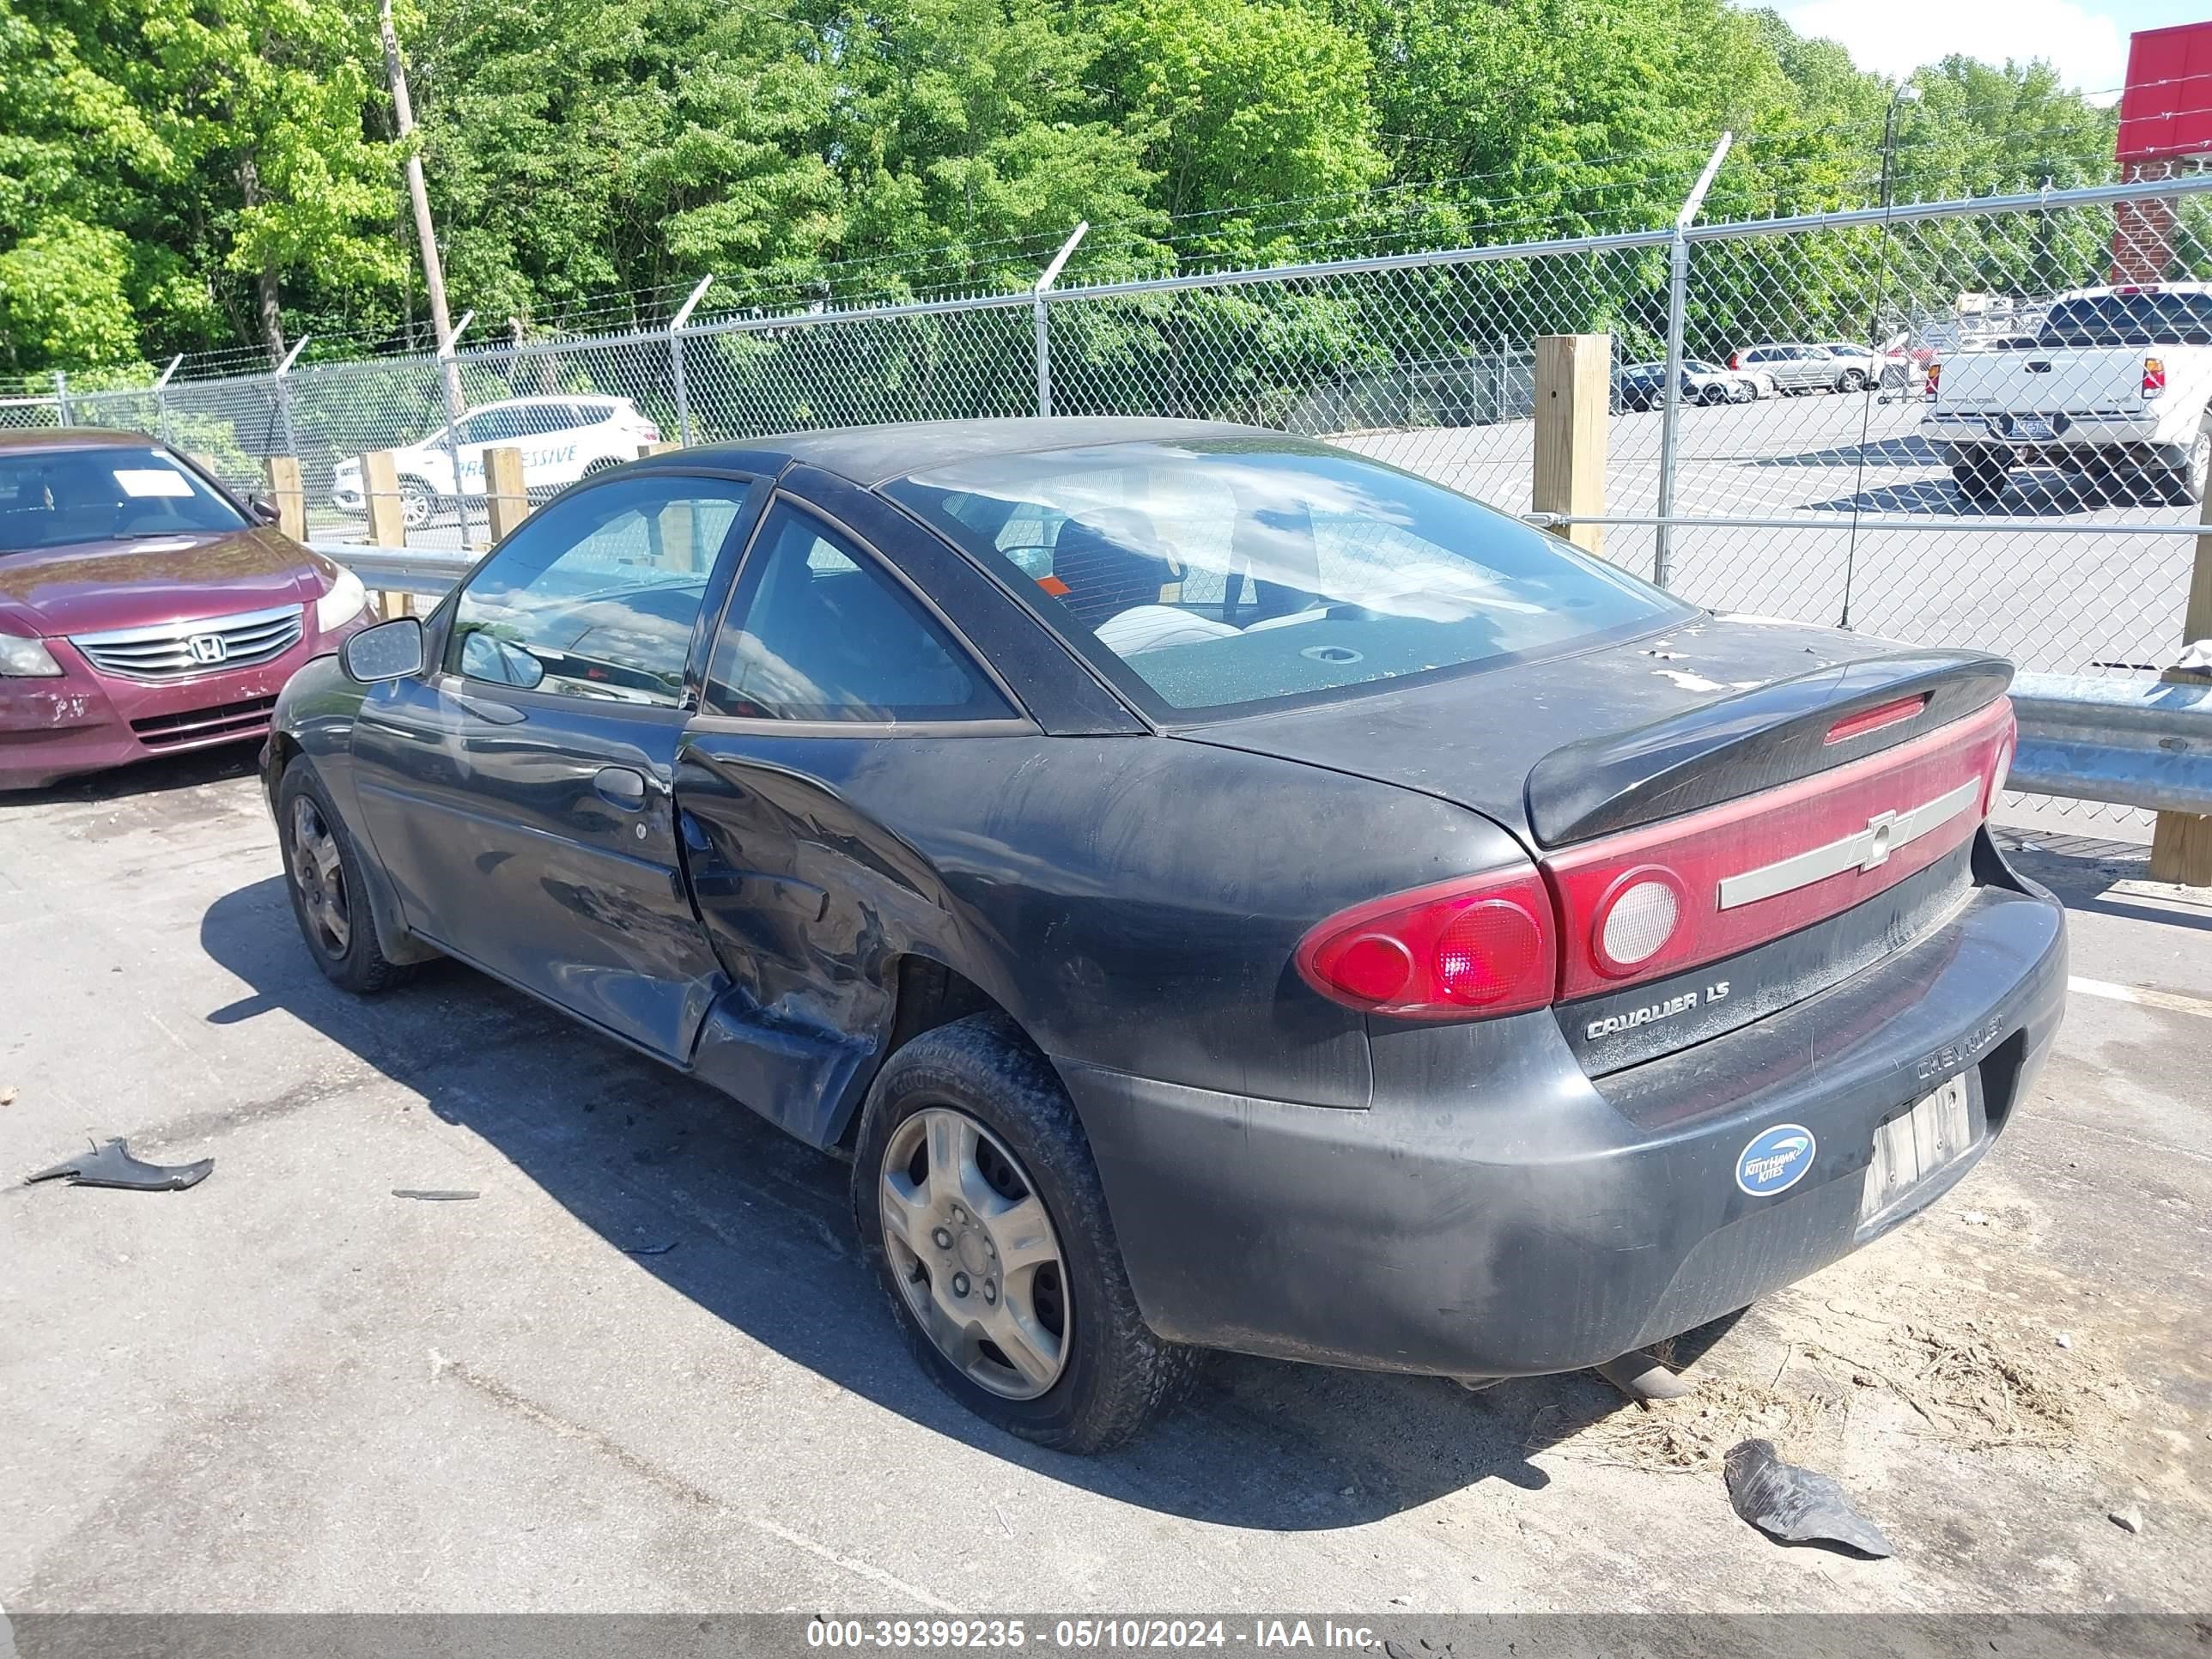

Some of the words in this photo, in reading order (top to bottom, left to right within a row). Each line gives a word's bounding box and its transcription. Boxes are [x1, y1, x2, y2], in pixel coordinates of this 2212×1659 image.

[1586, 992, 1698, 1042] CAVALIER
[1704, 981, 1730, 1005] LS
[1917, 1012, 2003, 1079] CHEVROLET
[1758, 1165, 1784, 1183] KITES
